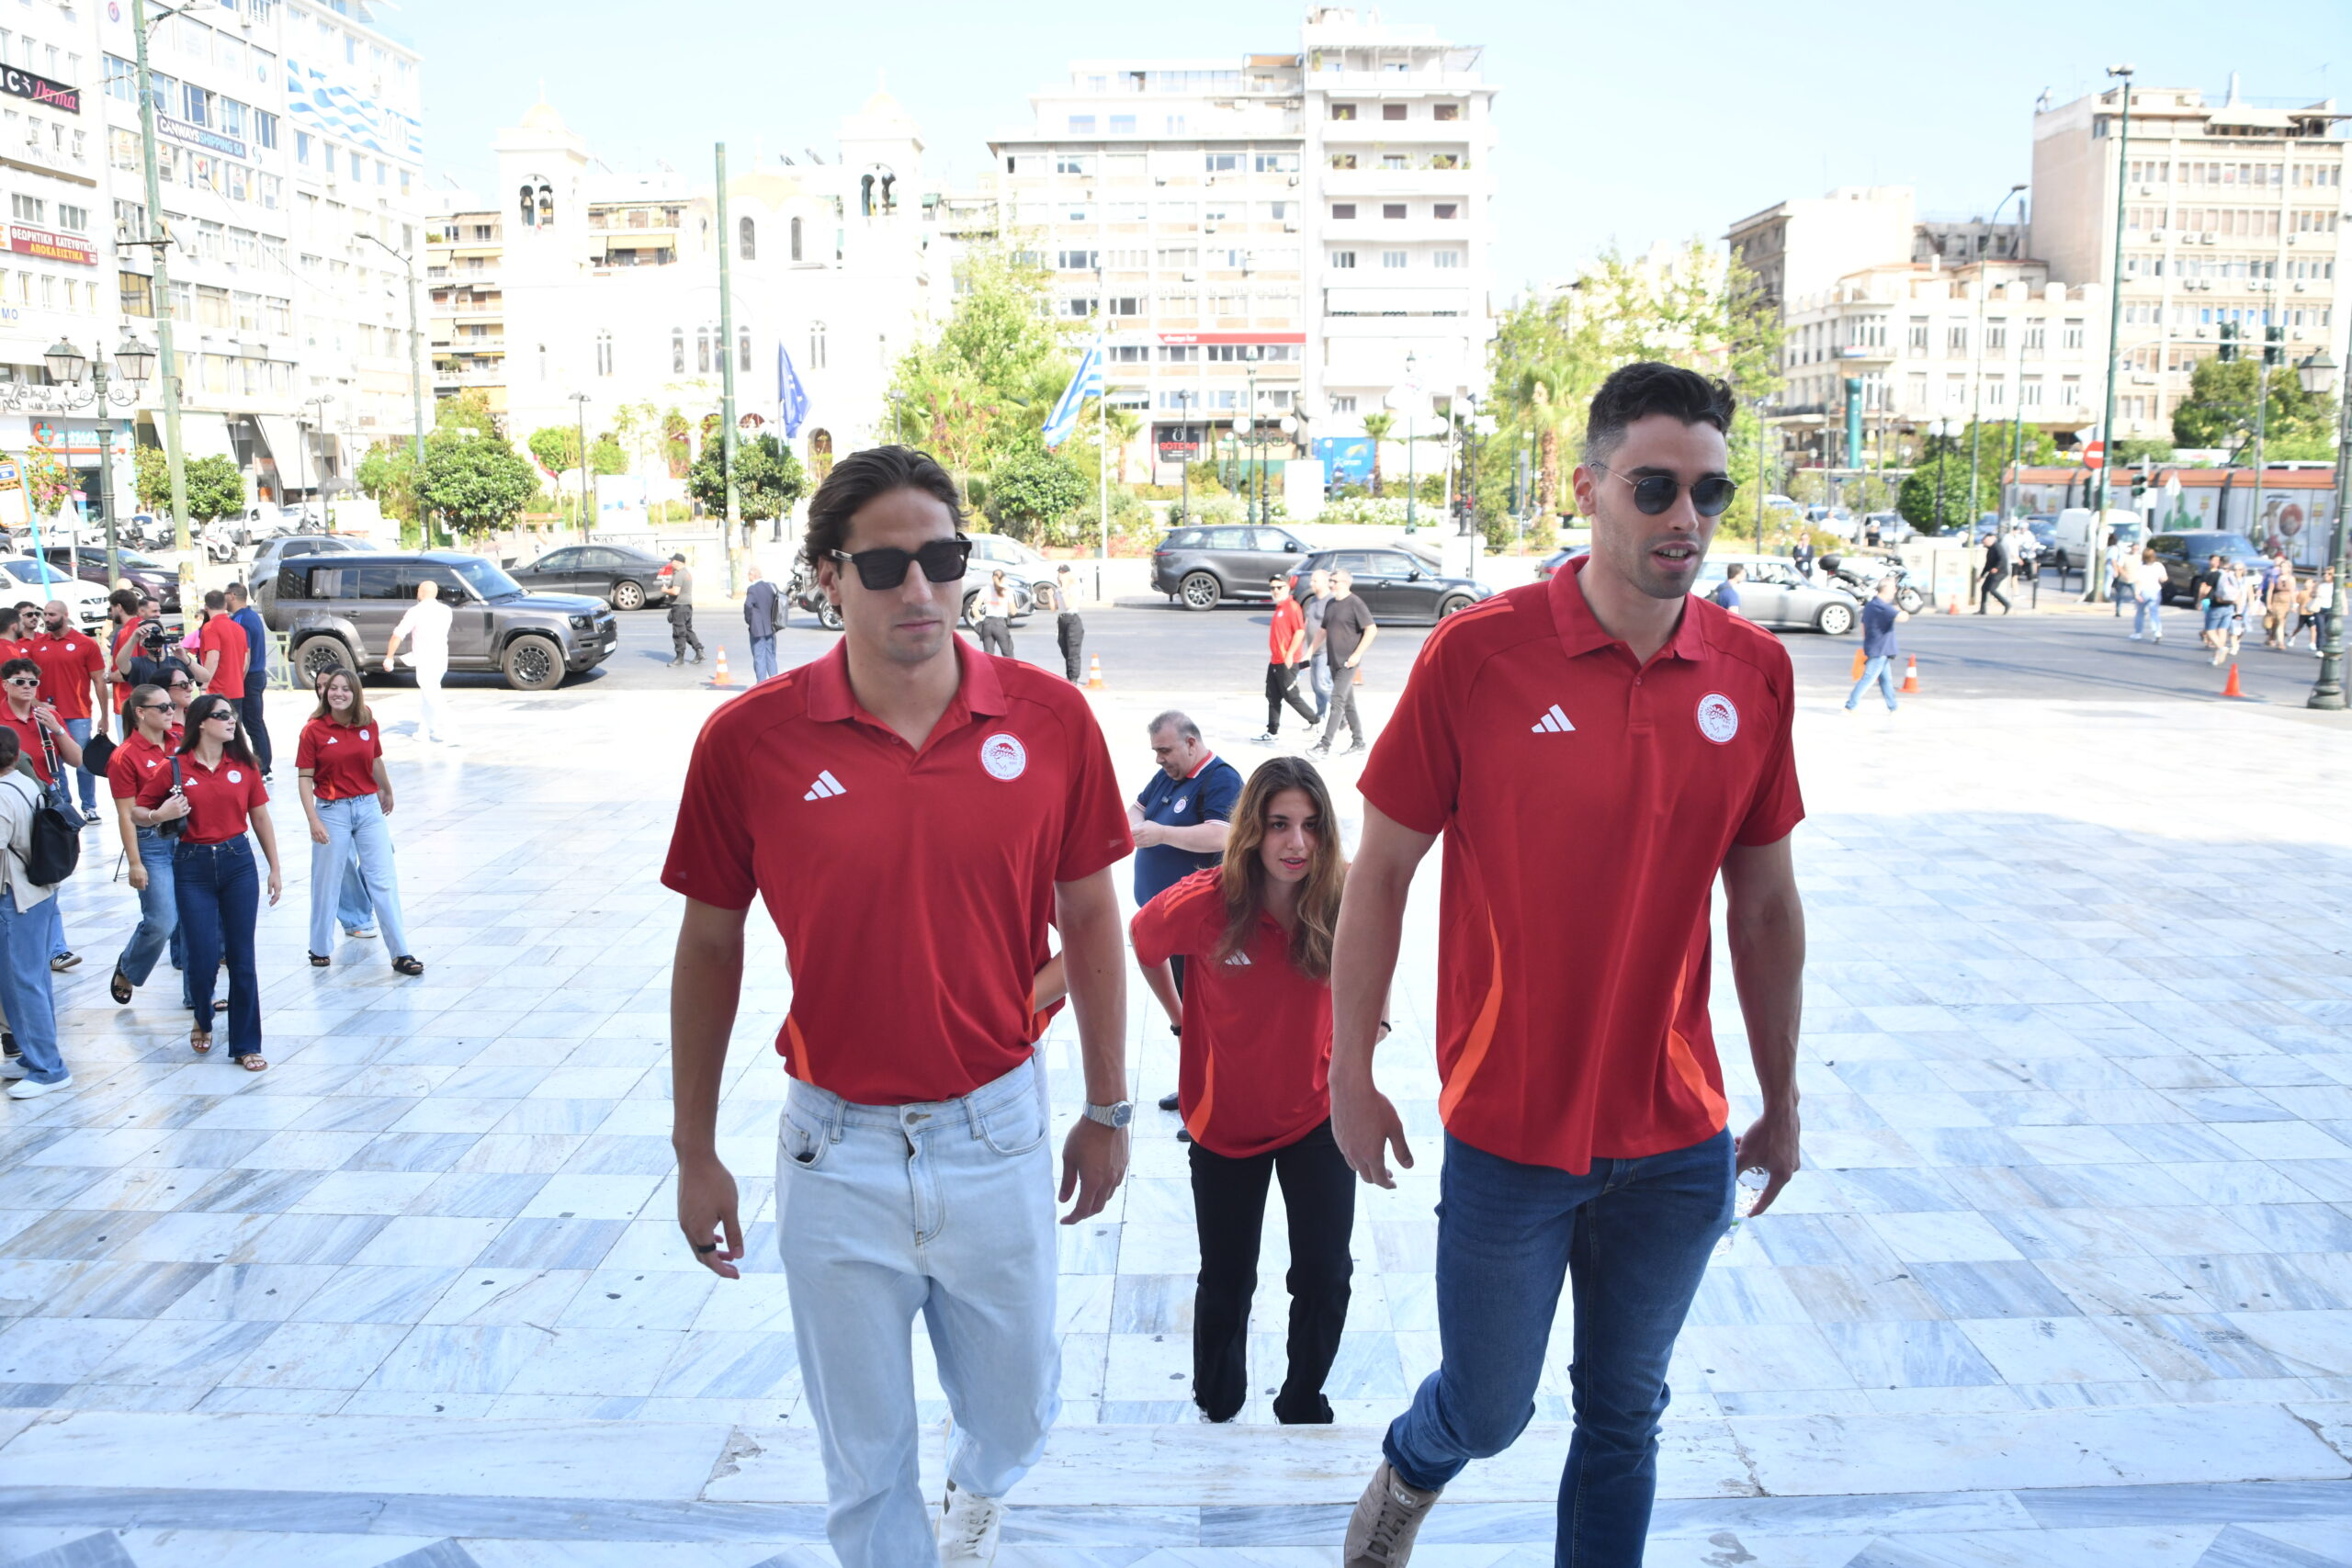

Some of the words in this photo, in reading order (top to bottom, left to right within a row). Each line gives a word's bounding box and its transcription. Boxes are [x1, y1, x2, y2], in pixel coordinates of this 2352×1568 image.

[34, 81, 76, 109] Derma
[199, 132, 233, 153] SHIPPING
[233, 143, 244, 156] SA
[30, 243, 85, 261] ΑΠΟΚΛΕΙΣΤΙΚΑ
